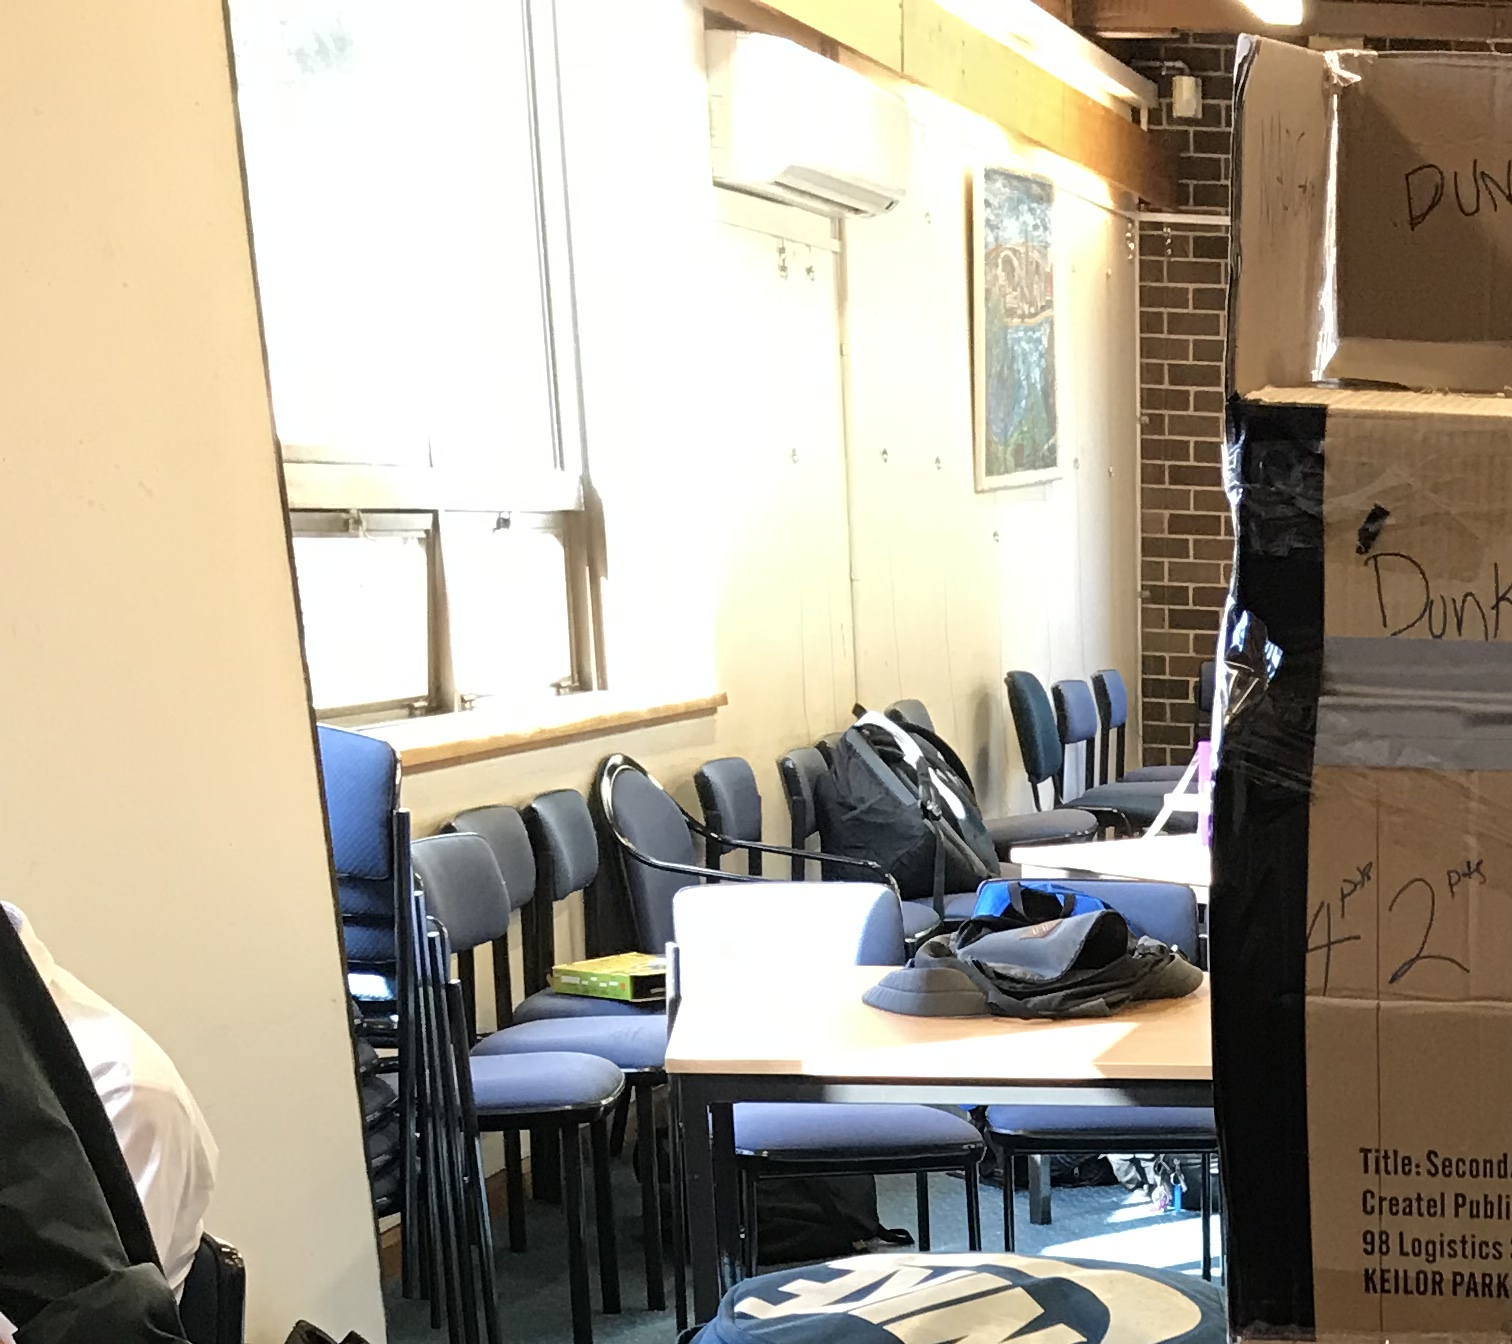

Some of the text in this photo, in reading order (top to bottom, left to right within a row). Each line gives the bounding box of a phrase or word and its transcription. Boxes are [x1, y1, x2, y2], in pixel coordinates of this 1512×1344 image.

[1388, 877, 1471, 985] 2
[1358, 1147, 1422, 1177] Title:
[1361, 1229, 1391, 1257] 98
[1398, 1230, 1504, 1264] Logistics
[1363, 1267, 1445, 1297] KEILOR
[1451, 1271, 1510, 1300] PARK
